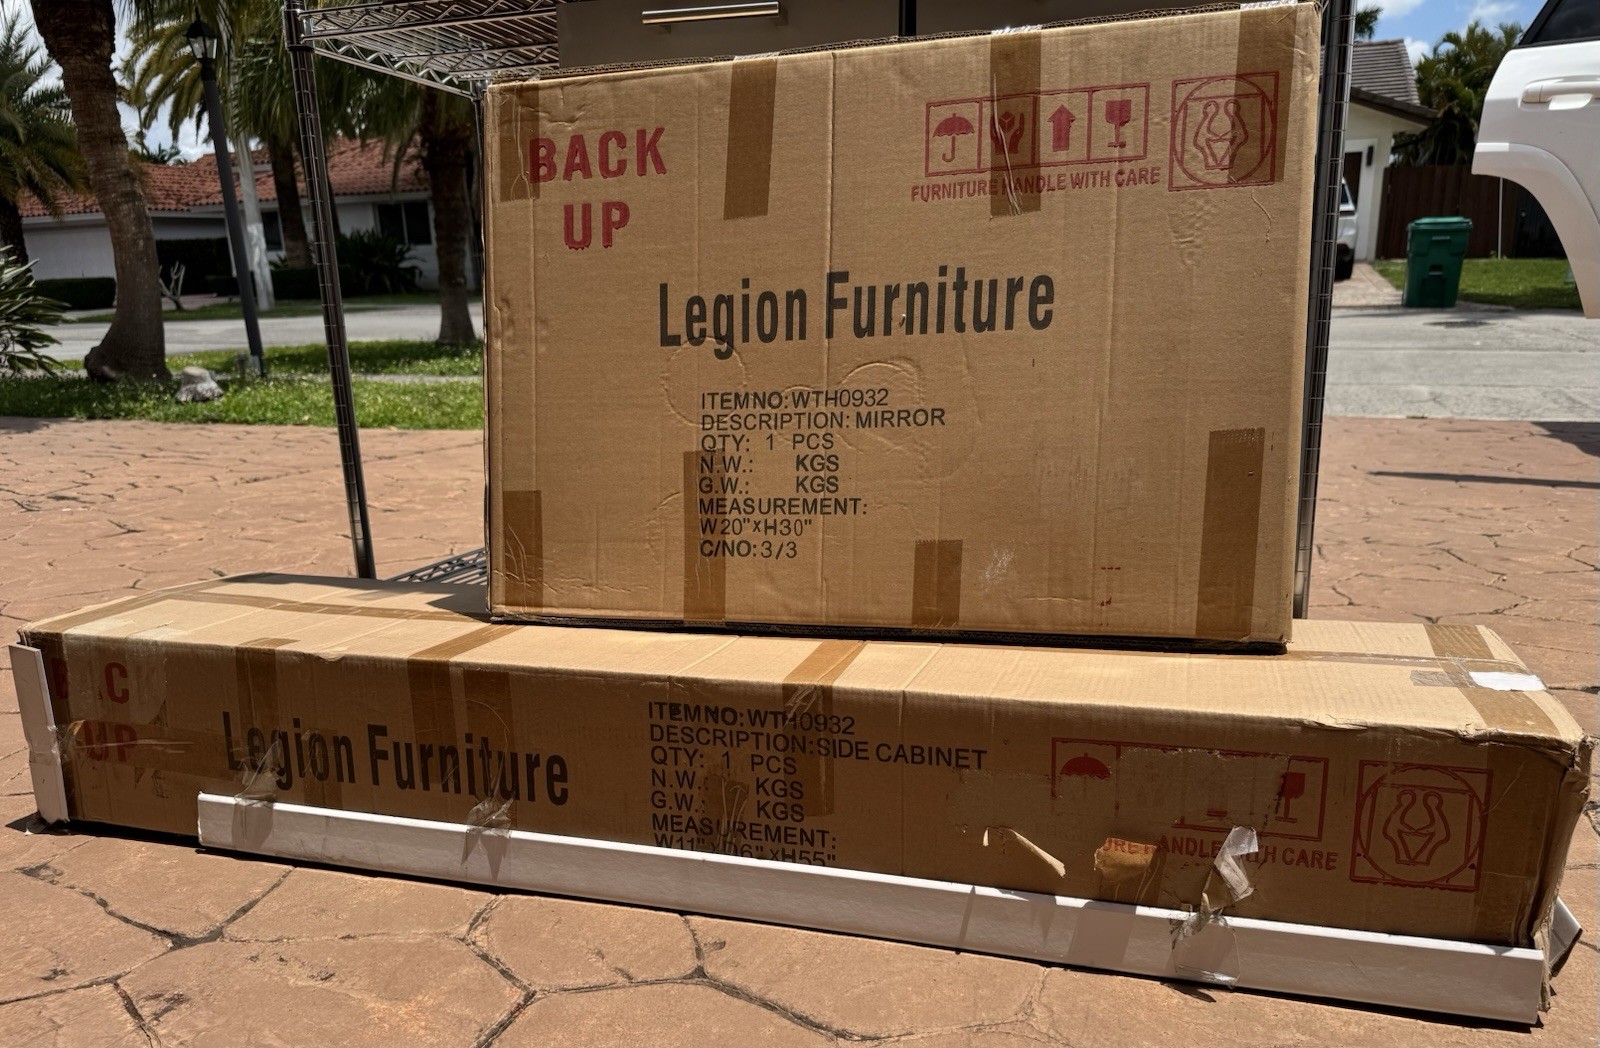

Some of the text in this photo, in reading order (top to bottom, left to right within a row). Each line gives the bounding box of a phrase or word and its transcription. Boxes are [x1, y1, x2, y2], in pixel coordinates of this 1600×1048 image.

[528, 127, 667, 183] BACK
[910, 166, 1162, 202] FURNITURE HANDLE WITH CARE
[563, 201, 631, 250] UP
[659, 265, 1056, 360] Legion Furniture
[701, 408, 946, 431] DESCRIPTION: MIRROR
[701, 433, 834, 452] QTY: 1 PCS
[700, 454, 840, 474] N.W.: KGS
[699, 475, 840, 494] G.W.: KGS
[699, 497, 868, 515] MEASUREMENT:
[83, 721, 138, 762] UP
[222, 711, 569, 806] Legion Furniture
[651, 745, 797, 775] QTY: 1 PCS
[875, 743, 988, 770] CABINET
[755, 777, 804, 800] KGS
[756, 800, 805, 823] KGS
[652, 813, 837, 849] MEASUREMENT:
[1281, 849, 1339, 871] CARE
